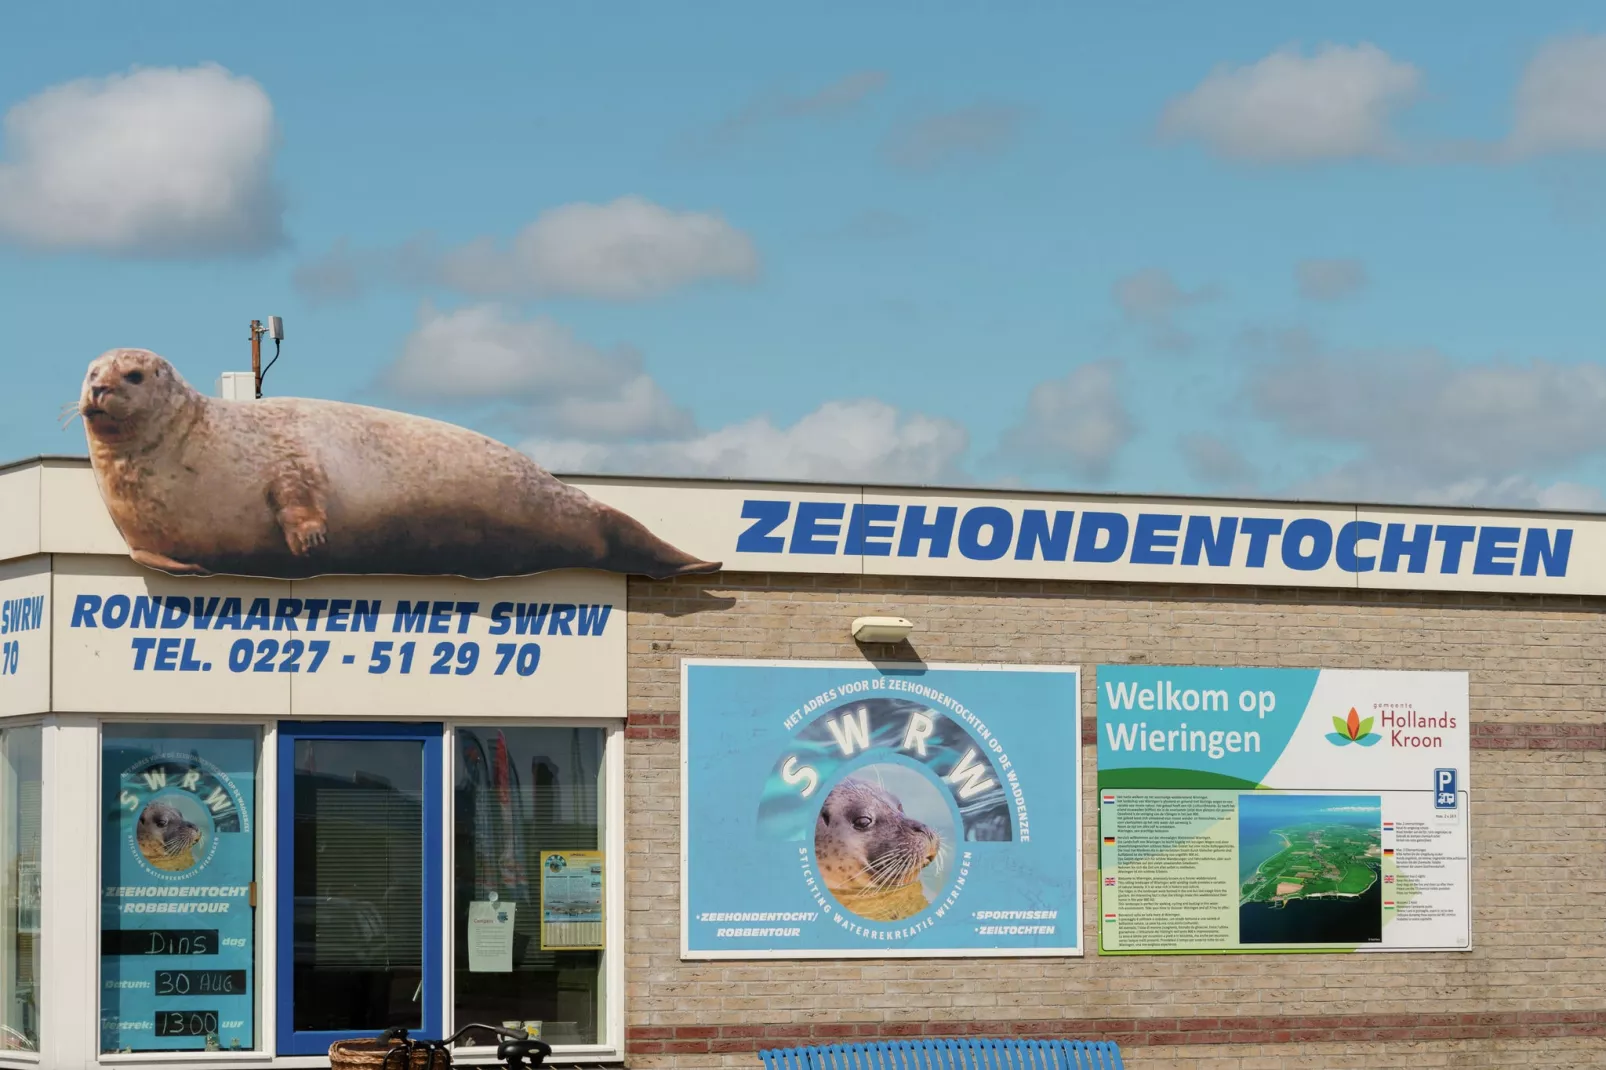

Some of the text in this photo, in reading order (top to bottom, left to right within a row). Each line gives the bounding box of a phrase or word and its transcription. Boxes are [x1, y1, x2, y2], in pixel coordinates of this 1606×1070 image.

[735, 500, 1573, 577] ZEEHONDENTOCHTEN
[1, 595, 44, 634] SWRW
[70, 594, 613, 636] RONDVAARTEN MET SWRW
[2, 640, 19, 675] 70
[131, 637, 541, 677] TEL. 0227 - 51 29 70
[1105, 681, 1276, 718] Welkom op
[1381, 710, 1457, 729] Hollands
[1106, 722, 1261, 760] Wieringen
[1391, 730, 1442, 747] Kroon
[783, 710, 803, 730] HET
[803, 688, 837, 716] ADRES
[838, 680, 870, 696] VOOR
[888, 679, 990, 741] ZEEHONDENTOCHTEN
[989, 738, 1003, 753] OP
[998, 753, 1011, 771] DE
[1005, 770, 1031, 843] WADDENZEE
[1439, 771, 1452, 791] P
[799, 847, 972, 941] STICHTING WATERREKREATIE WIERINGEN
[124, 902, 230, 913] ROBBENTOUR
[701, 912, 819, 922] ZEEHONDENTOCHT/
[976, 911, 1057, 920] SPORTVISSEN
[717, 928, 800, 937] ROBBENTOUR
[979, 926, 1055, 935] ZEILTOCHTEN
[222, 937, 246, 947] dag
[159, 972, 190, 994] 30
[200, 973, 233, 993] AUG
[221, 1021, 244, 1029] uur
